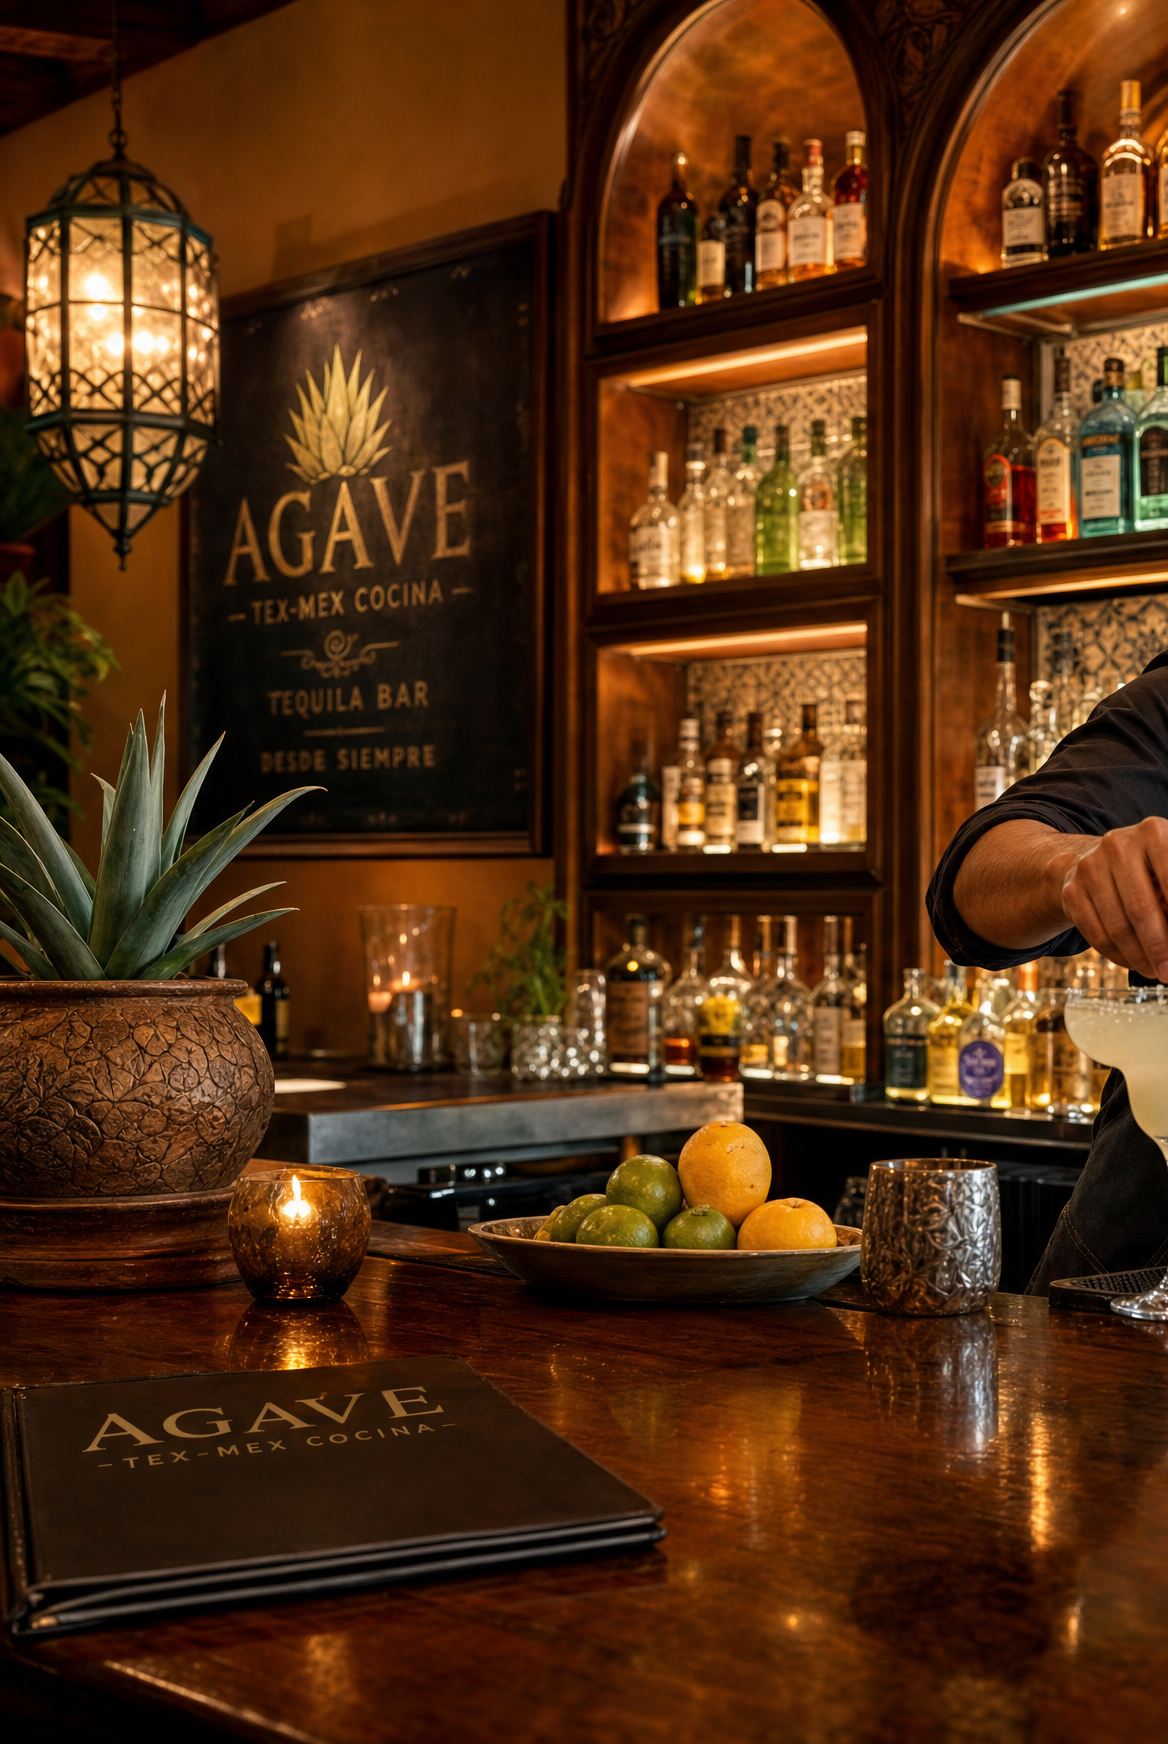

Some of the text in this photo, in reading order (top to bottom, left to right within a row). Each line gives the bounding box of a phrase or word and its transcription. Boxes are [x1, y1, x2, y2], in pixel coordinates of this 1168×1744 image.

[222, 459, 472, 587] AGAVE
[251, 578, 444, 626] TEX-MEX COCINA
[266, 680, 430, 720] TEQUILA BAR
[260, 744, 437, 774] DESDE SIEMPRE
[82, 1386, 445, 1453] AGAVE
[122, 1422, 436, 1469] TEX-MEX COCINA
